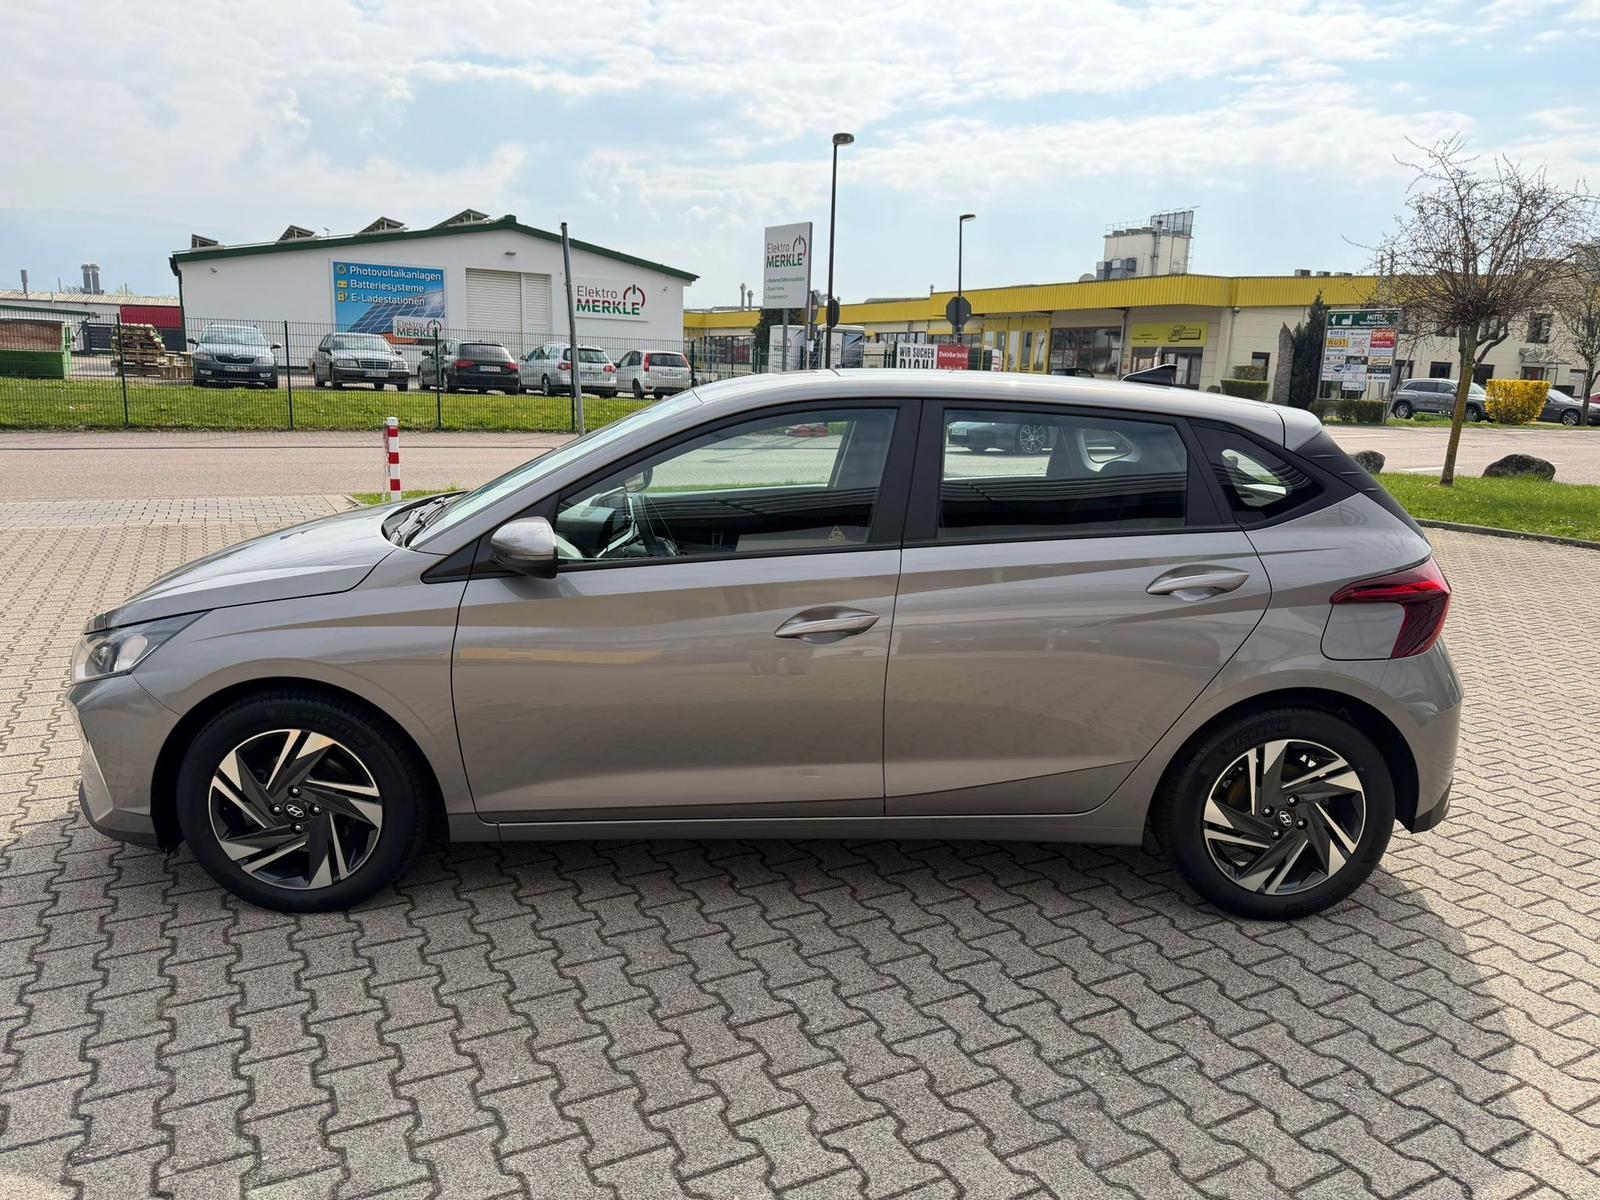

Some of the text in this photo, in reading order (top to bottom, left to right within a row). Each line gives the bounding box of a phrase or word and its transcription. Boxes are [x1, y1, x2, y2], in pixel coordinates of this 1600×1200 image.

[767, 243, 790, 254] Elektro
[766, 253, 803, 269] MERKLE
[349, 266, 441, 281] Photovoltaikanlagen
[350, 279, 424, 293] Batteriesysteme
[576, 285, 618, 299] Elektro
[351, 292, 425, 306] E-Ladestationen
[576, 298, 640, 316] MERKLE
[396, 320, 424, 329] Elektro
[899, 346, 935, 358] WIR SUCHEN
